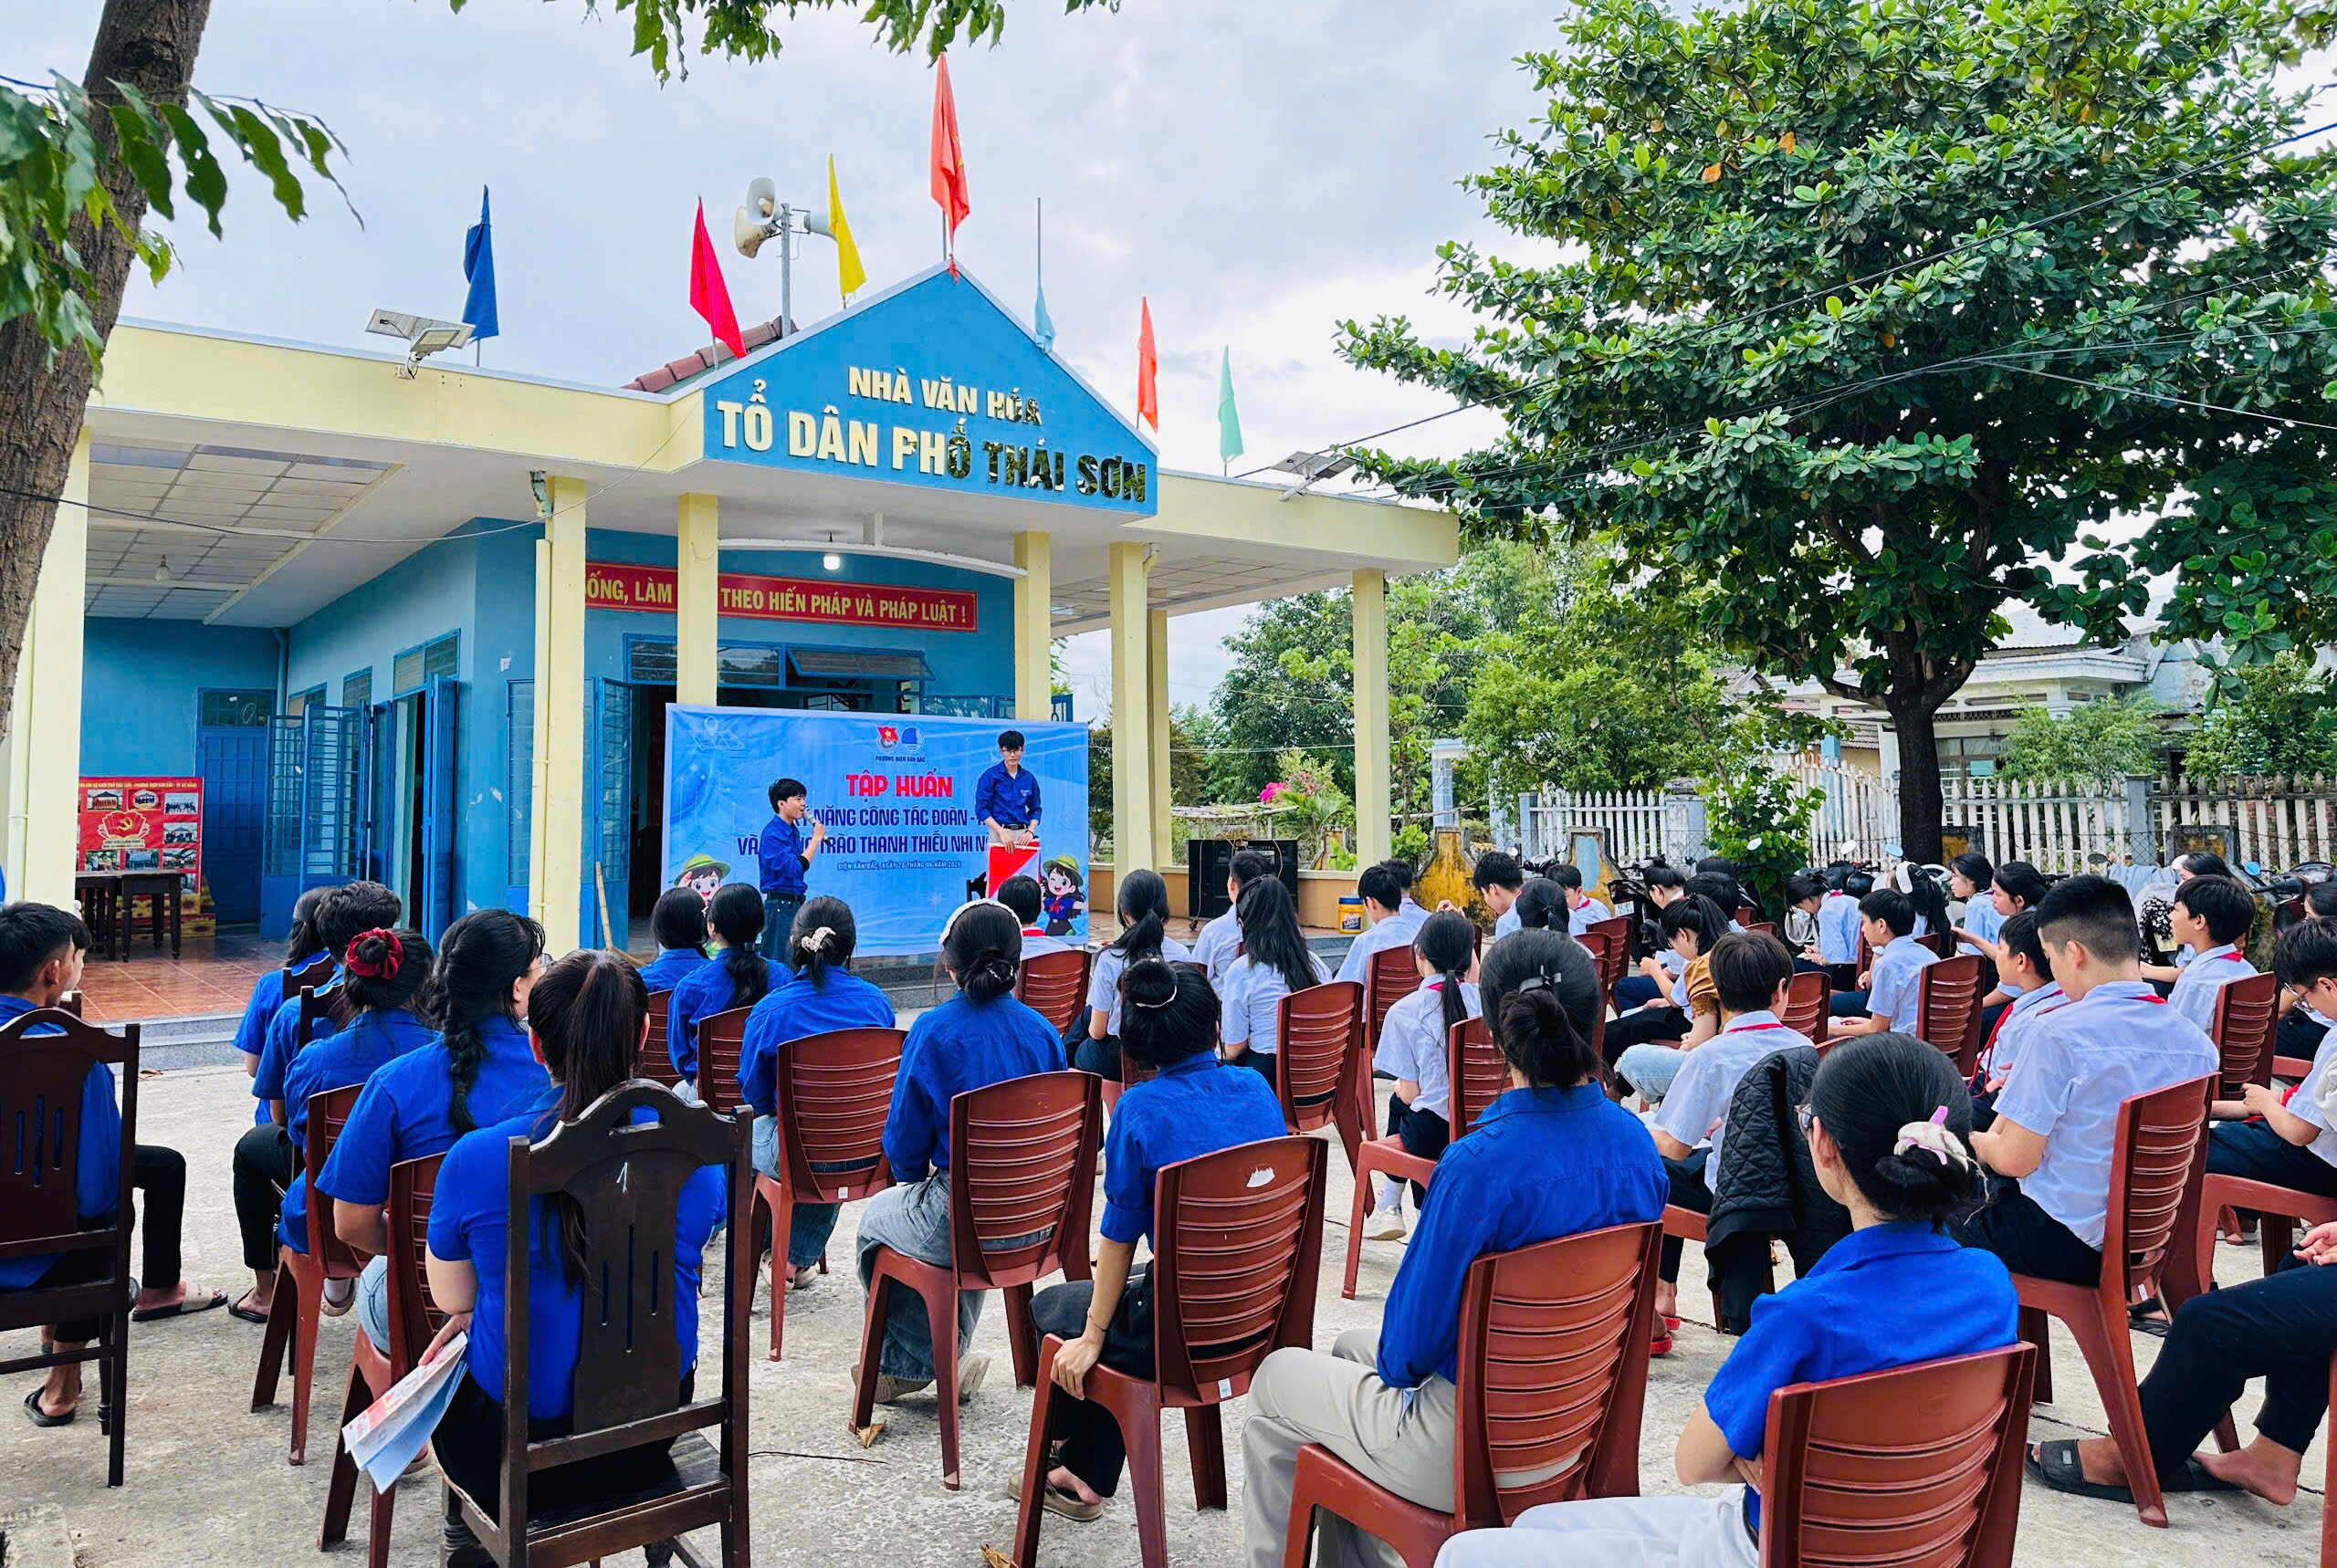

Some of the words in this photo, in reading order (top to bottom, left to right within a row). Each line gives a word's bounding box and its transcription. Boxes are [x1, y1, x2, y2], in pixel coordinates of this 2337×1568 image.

[847, 366, 912, 404] NHÀ
[920, 375, 978, 414] VĂN
[987, 387, 1043, 425] HÓA
[717, 379, 773, 452] TỔ
[789, 404, 878, 467] DÂN
[892, 417, 971, 479] PHỐ
[982, 437, 1064, 493] THÁI
[1075, 455, 1147, 503] SƠN
[584, 571, 629, 604] ỐNG,
[634, 577, 673, 603] LÀM
[721, 588, 764, 610] THEO
[769, 585, 806, 612] HIẾN
[811, 591, 852, 615] PHÁP
[854, 593, 875, 617] VÀ
[879, 596, 918, 620] PHÁP
[921, 599, 957, 626] LUẬT
[845, 769, 888, 803] TẬP
[896, 768, 953, 798] HUẤN
[813, 805, 856, 826] NĂNG
[859, 805, 900, 826] CÔNG
[903, 806, 929, 826] TÁC
[931, 806, 968, 826] ĐOÀN
[737, 833, 759, 855] VÀ
[859, 835, 908, 854] THANH
[910, 830, 948, 853] THIẾU
[950, 835, 973, 852] NHI
